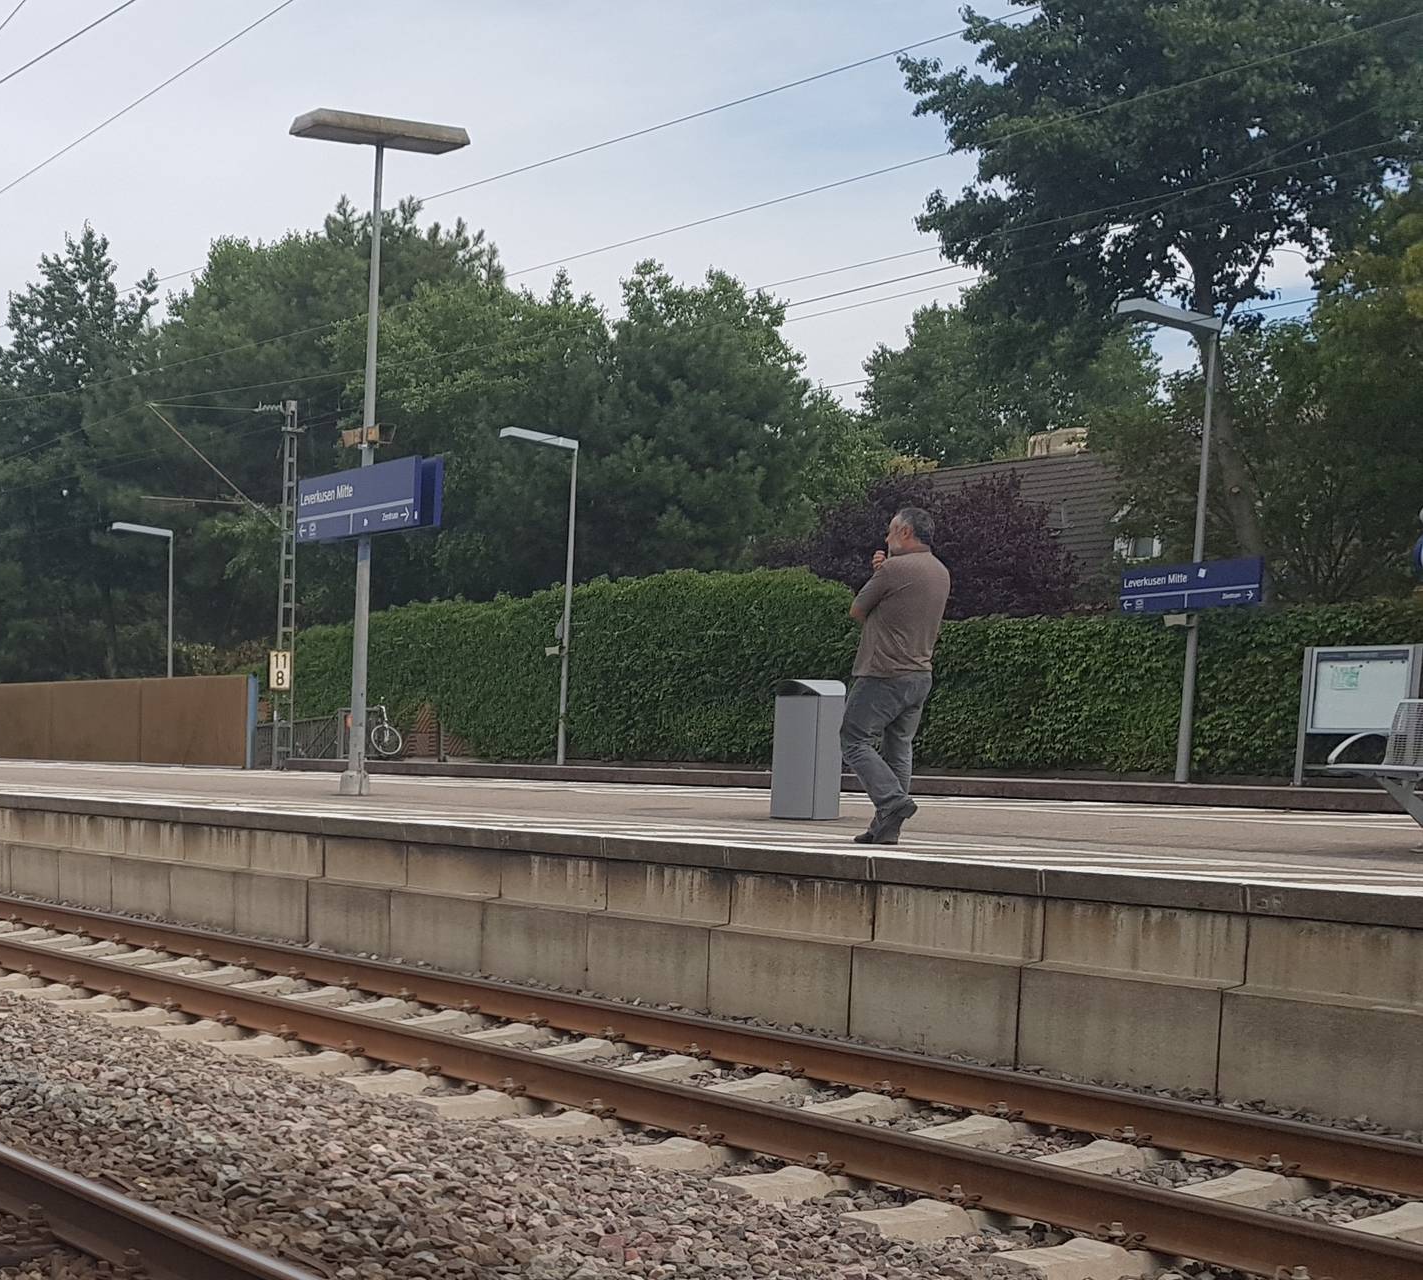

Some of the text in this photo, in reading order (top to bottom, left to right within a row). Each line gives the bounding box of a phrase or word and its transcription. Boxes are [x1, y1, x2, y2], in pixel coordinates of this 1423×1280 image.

[300, 483, 354, 507] Leverkusen Mitte
[1123, 573, 1188, 589] Leverkusen Mitte
[273, 653, 287, 669] 11
[276, 670, 285, 686] 8
